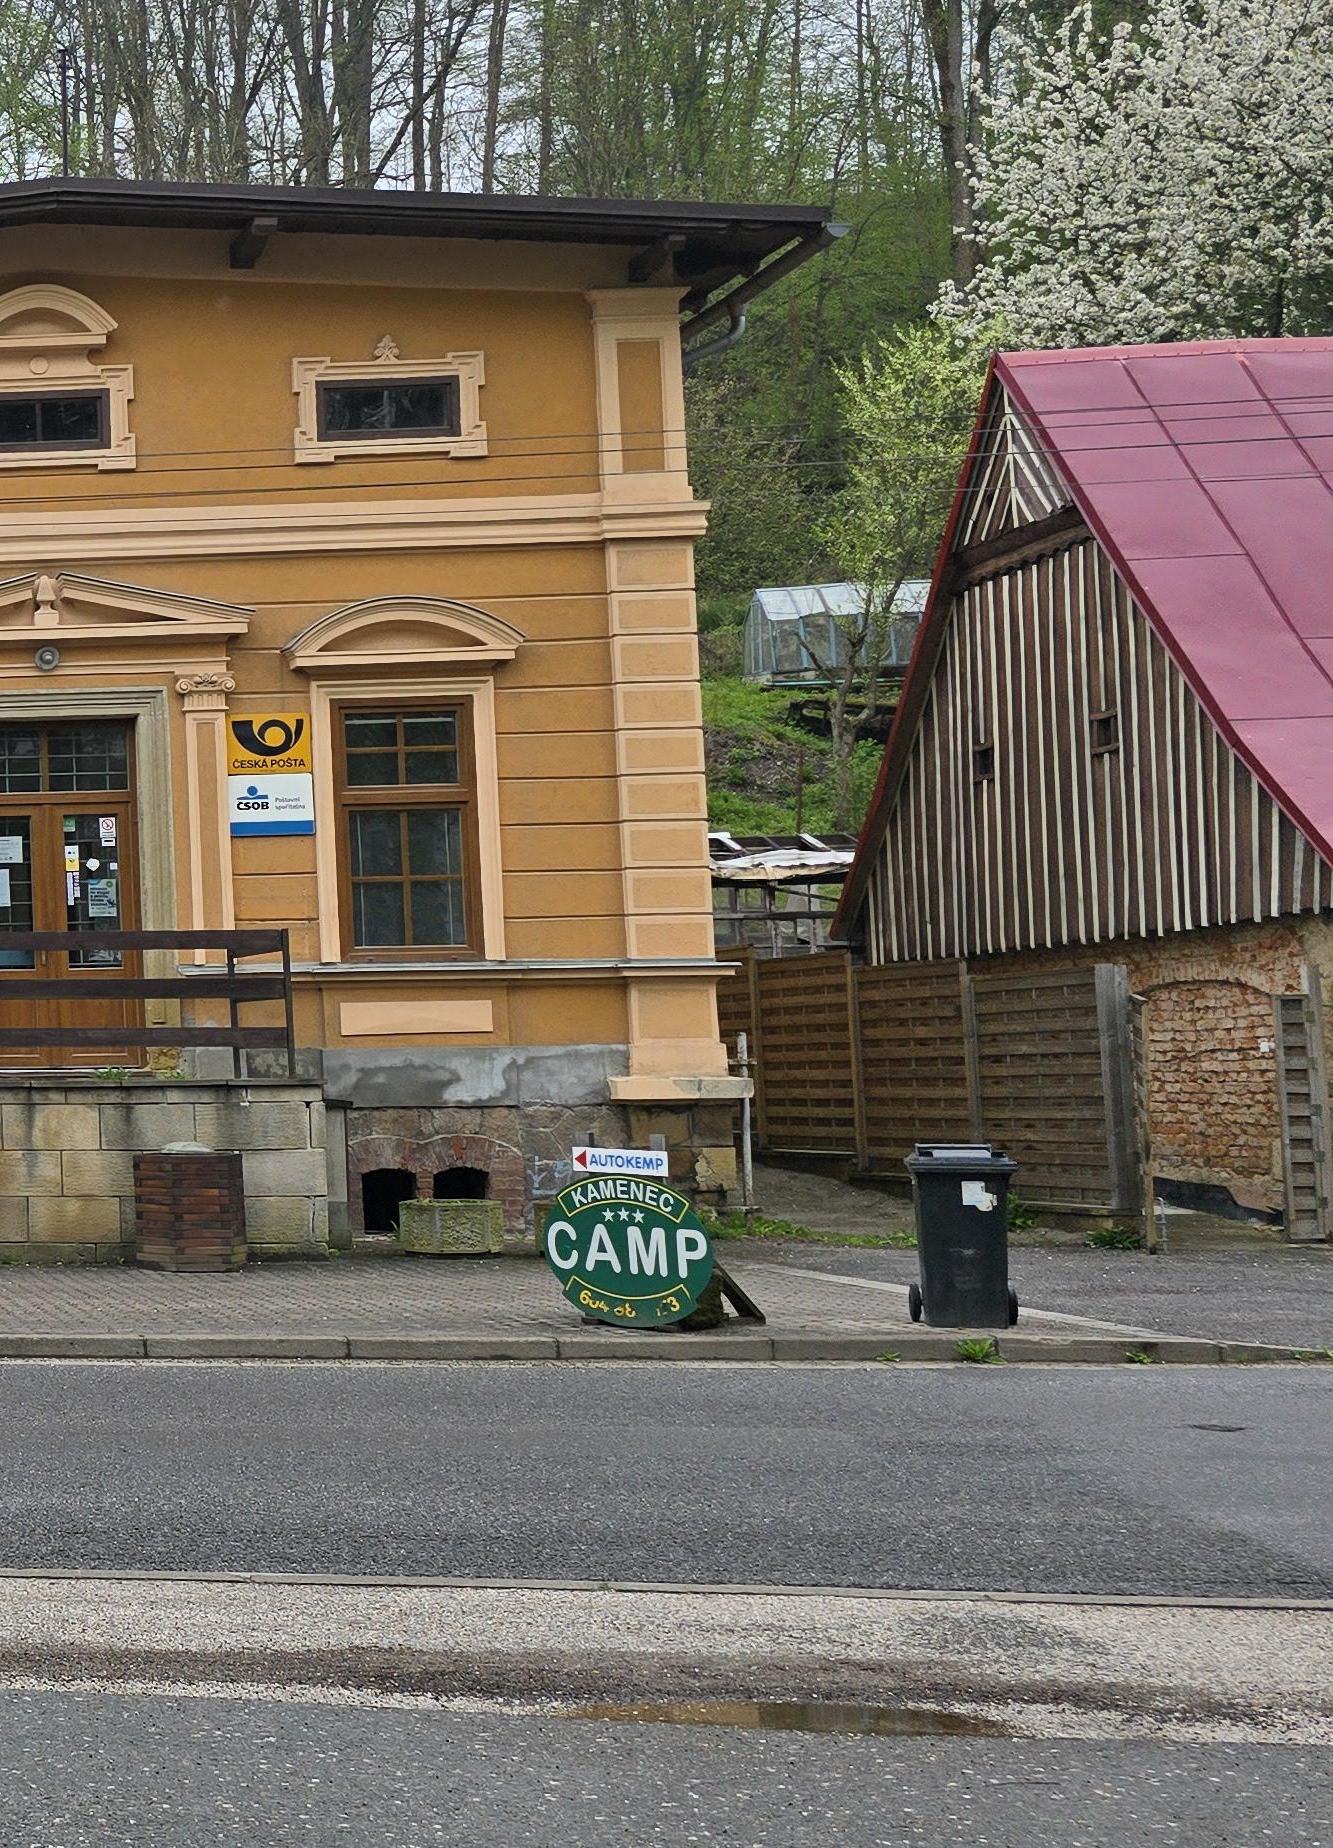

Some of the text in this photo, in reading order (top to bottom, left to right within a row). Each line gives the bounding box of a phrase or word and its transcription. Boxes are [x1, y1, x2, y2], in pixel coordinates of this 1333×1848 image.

[232, 757, 306, 769] ČESKÁ POŠTA
[236, 801, 270, 810] ČSOB
[589, 1153, 664, 1171] AUTOKEMP
[571, 1180, 674, 1212] KAMENEC
[548, 1221, 707, 1278] CAMP
